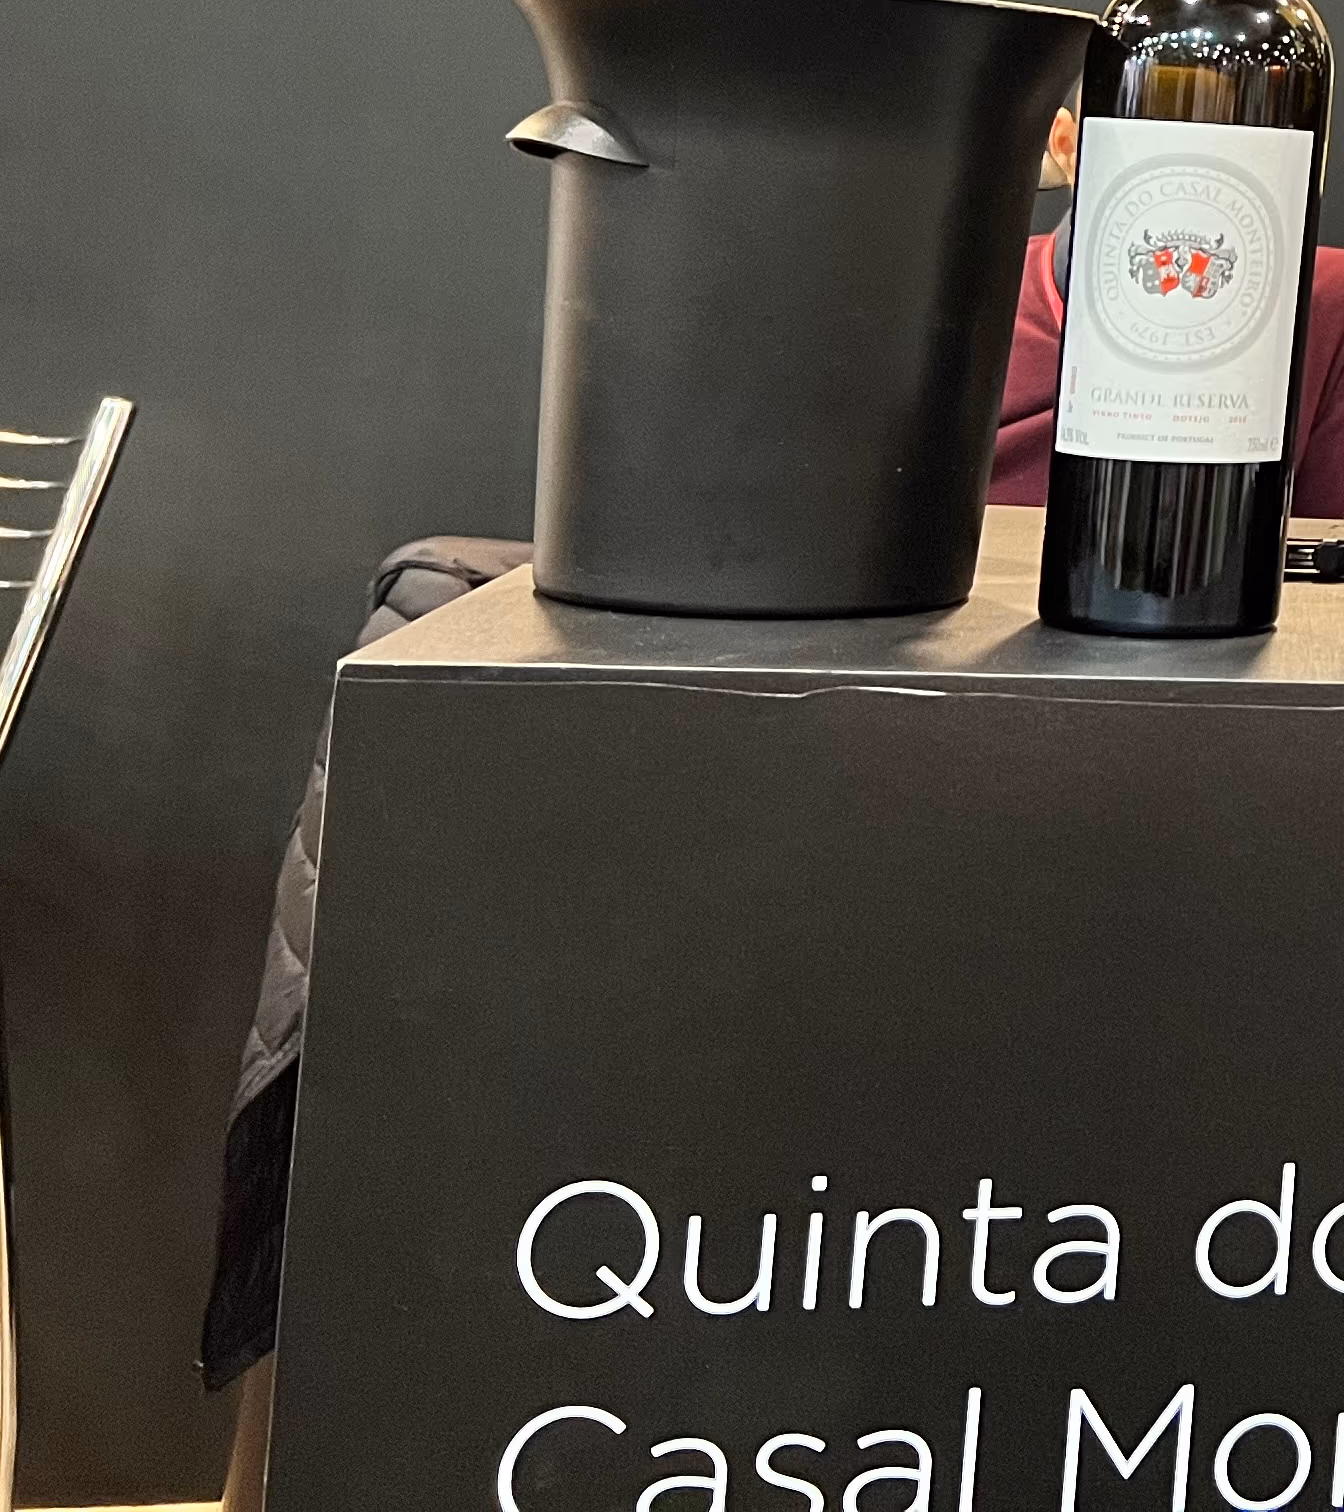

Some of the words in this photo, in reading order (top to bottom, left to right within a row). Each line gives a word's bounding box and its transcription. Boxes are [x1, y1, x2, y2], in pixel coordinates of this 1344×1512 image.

[1173, 392, 1250, 409] RESERVA
[515, 1172, 1123, 1320] Quinta
[496, 1386, 983, 1512] Casal
